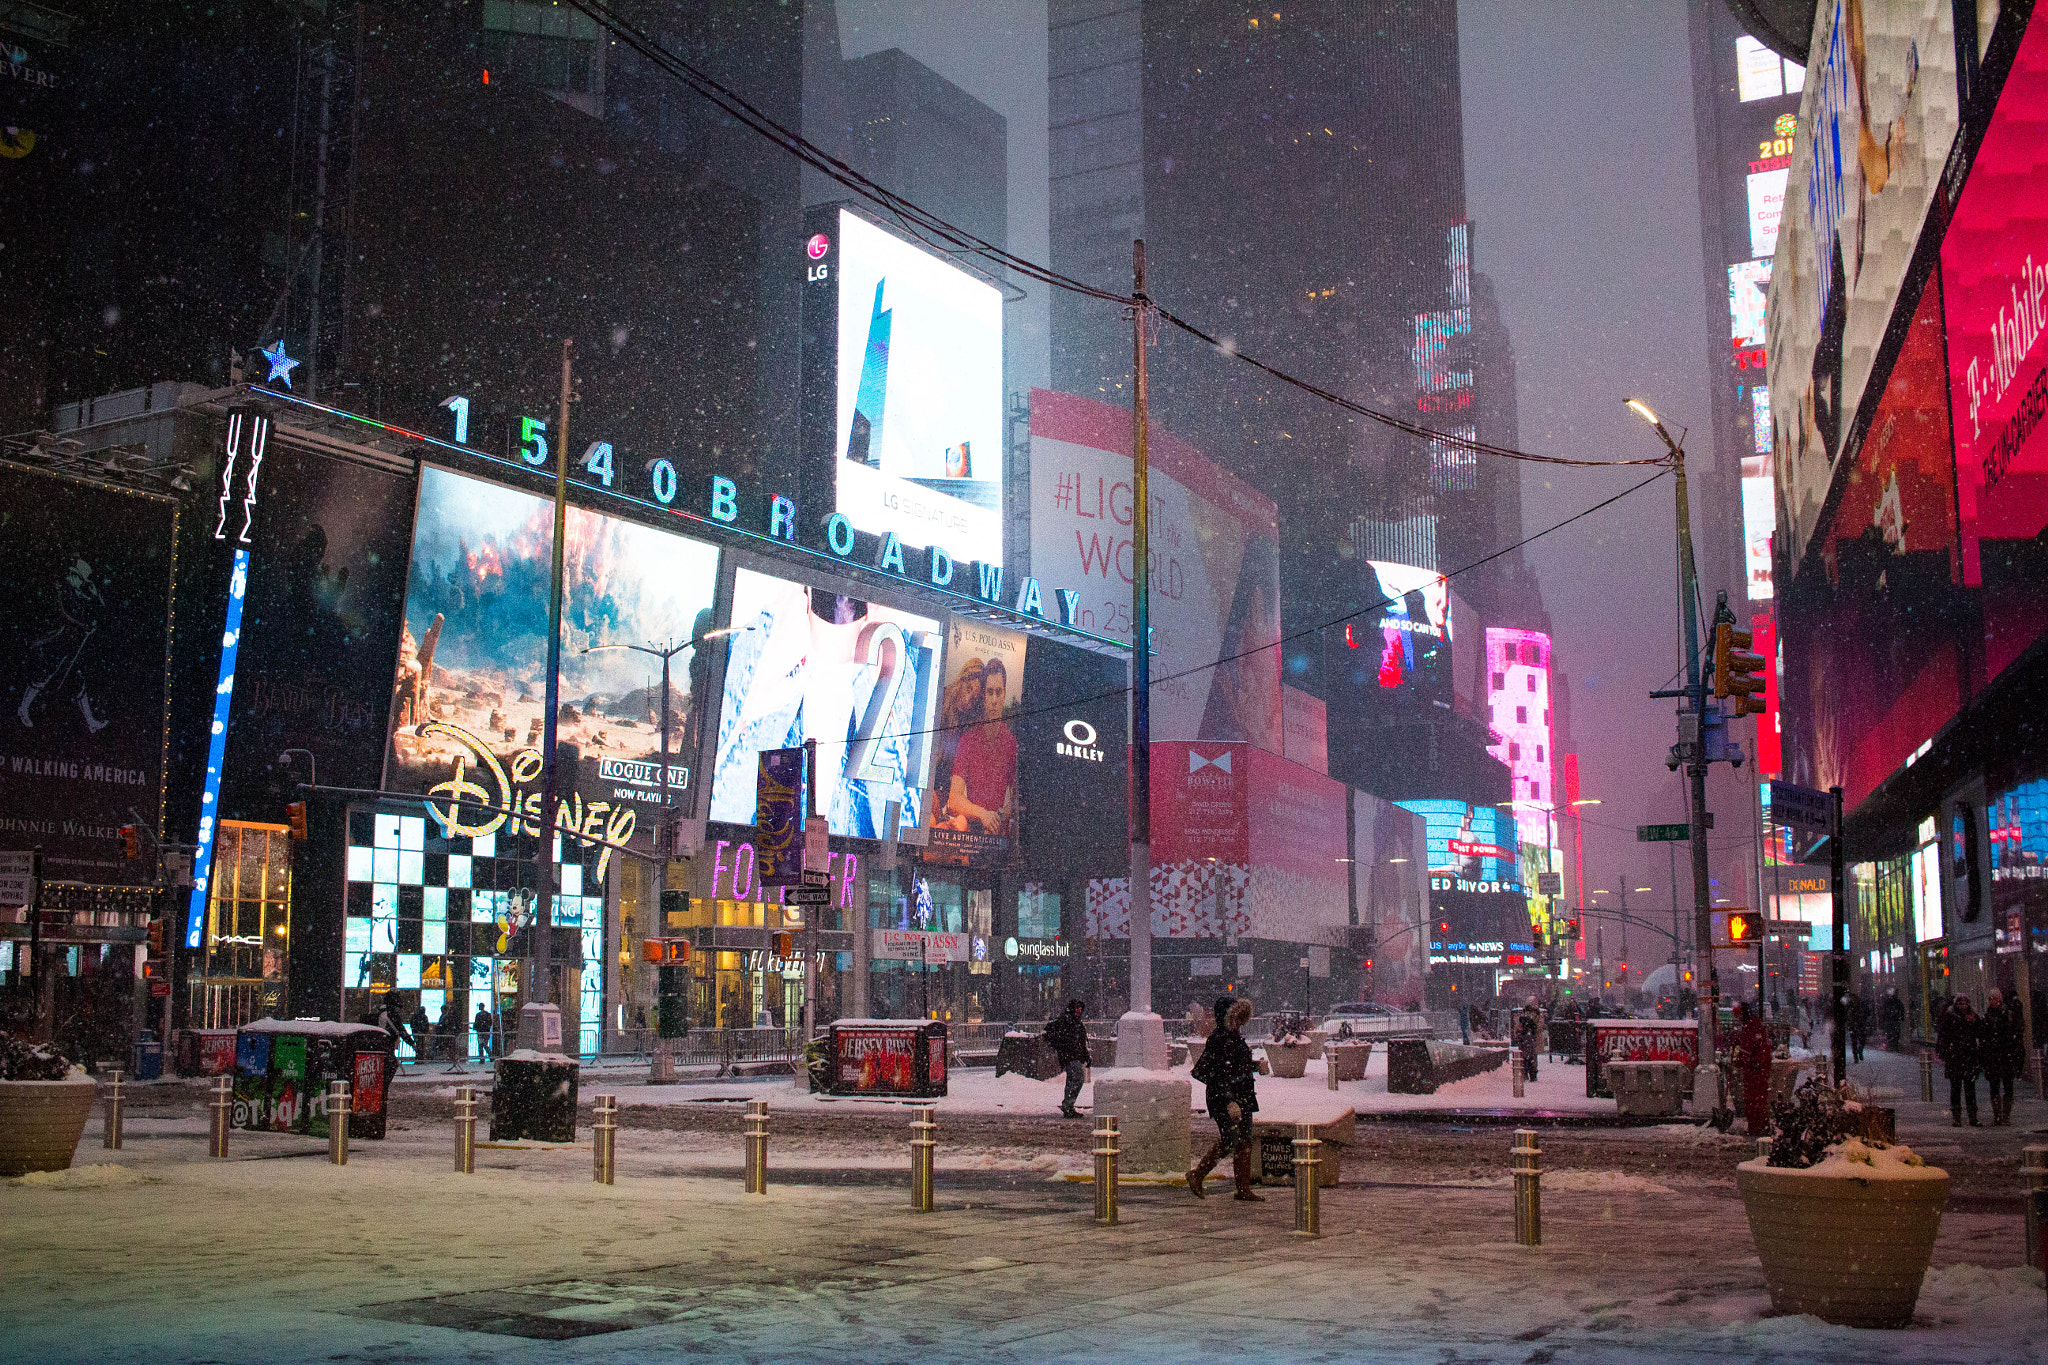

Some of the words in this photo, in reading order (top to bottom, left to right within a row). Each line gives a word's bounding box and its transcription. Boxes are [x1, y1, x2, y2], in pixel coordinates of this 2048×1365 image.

[808, 264, 828, 282] LG
[711, 475, 1081, 627] BROADWAY
[1103, 601, 1131, 634] 25
[1379, 617, 1400, 630] AND
[1401, 620, 1413, 631] SO
[1413, 622, 1430, 635] CAN
[979, 633, 998, 648] POLO
[1056, 742, 1104, 762] OAKLEY
[11, 756, 78, 779] WALKING
[83, 764, 146, 786] AMERICA
[604, 760, 651, 781] ROGUE
[614, 788, 635, 799] NOW
[637, 790, 672, 804] PLAYI
[934, 832, 950, 840] LIVE
[1789, 878, 1826, 891] DONALD
[798, 893, 811, 901] ONE
[812, 892, 826, 900] WAY
[1019, 940, 1055, 960] sunglass
[1055, 940, 1070, 957] hut
[1476, 942, 1504, 952] NEWS
[841, 1038, 883, 1059] JERSEY
